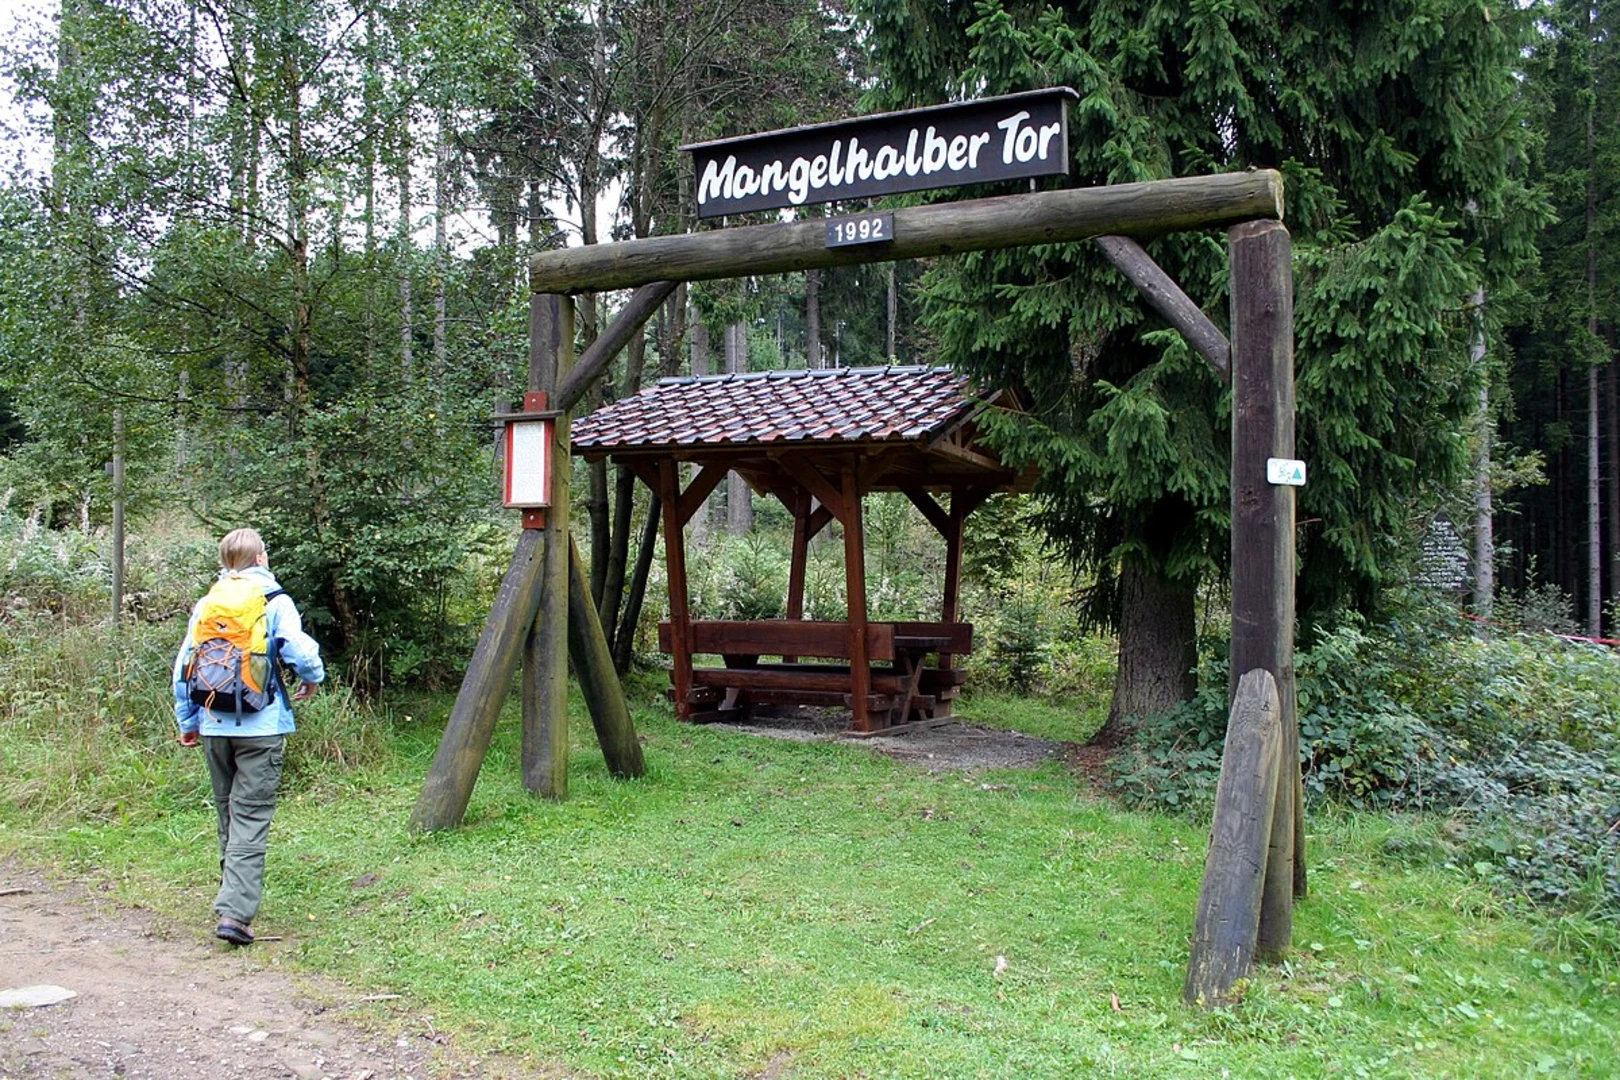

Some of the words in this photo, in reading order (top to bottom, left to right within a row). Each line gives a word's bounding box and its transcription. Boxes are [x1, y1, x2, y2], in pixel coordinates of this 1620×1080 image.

[697, 126, 991, 205] Mangelhalber
[997, 110, 1061, 165] Tor
[834, 218, 884, 243] 1992
